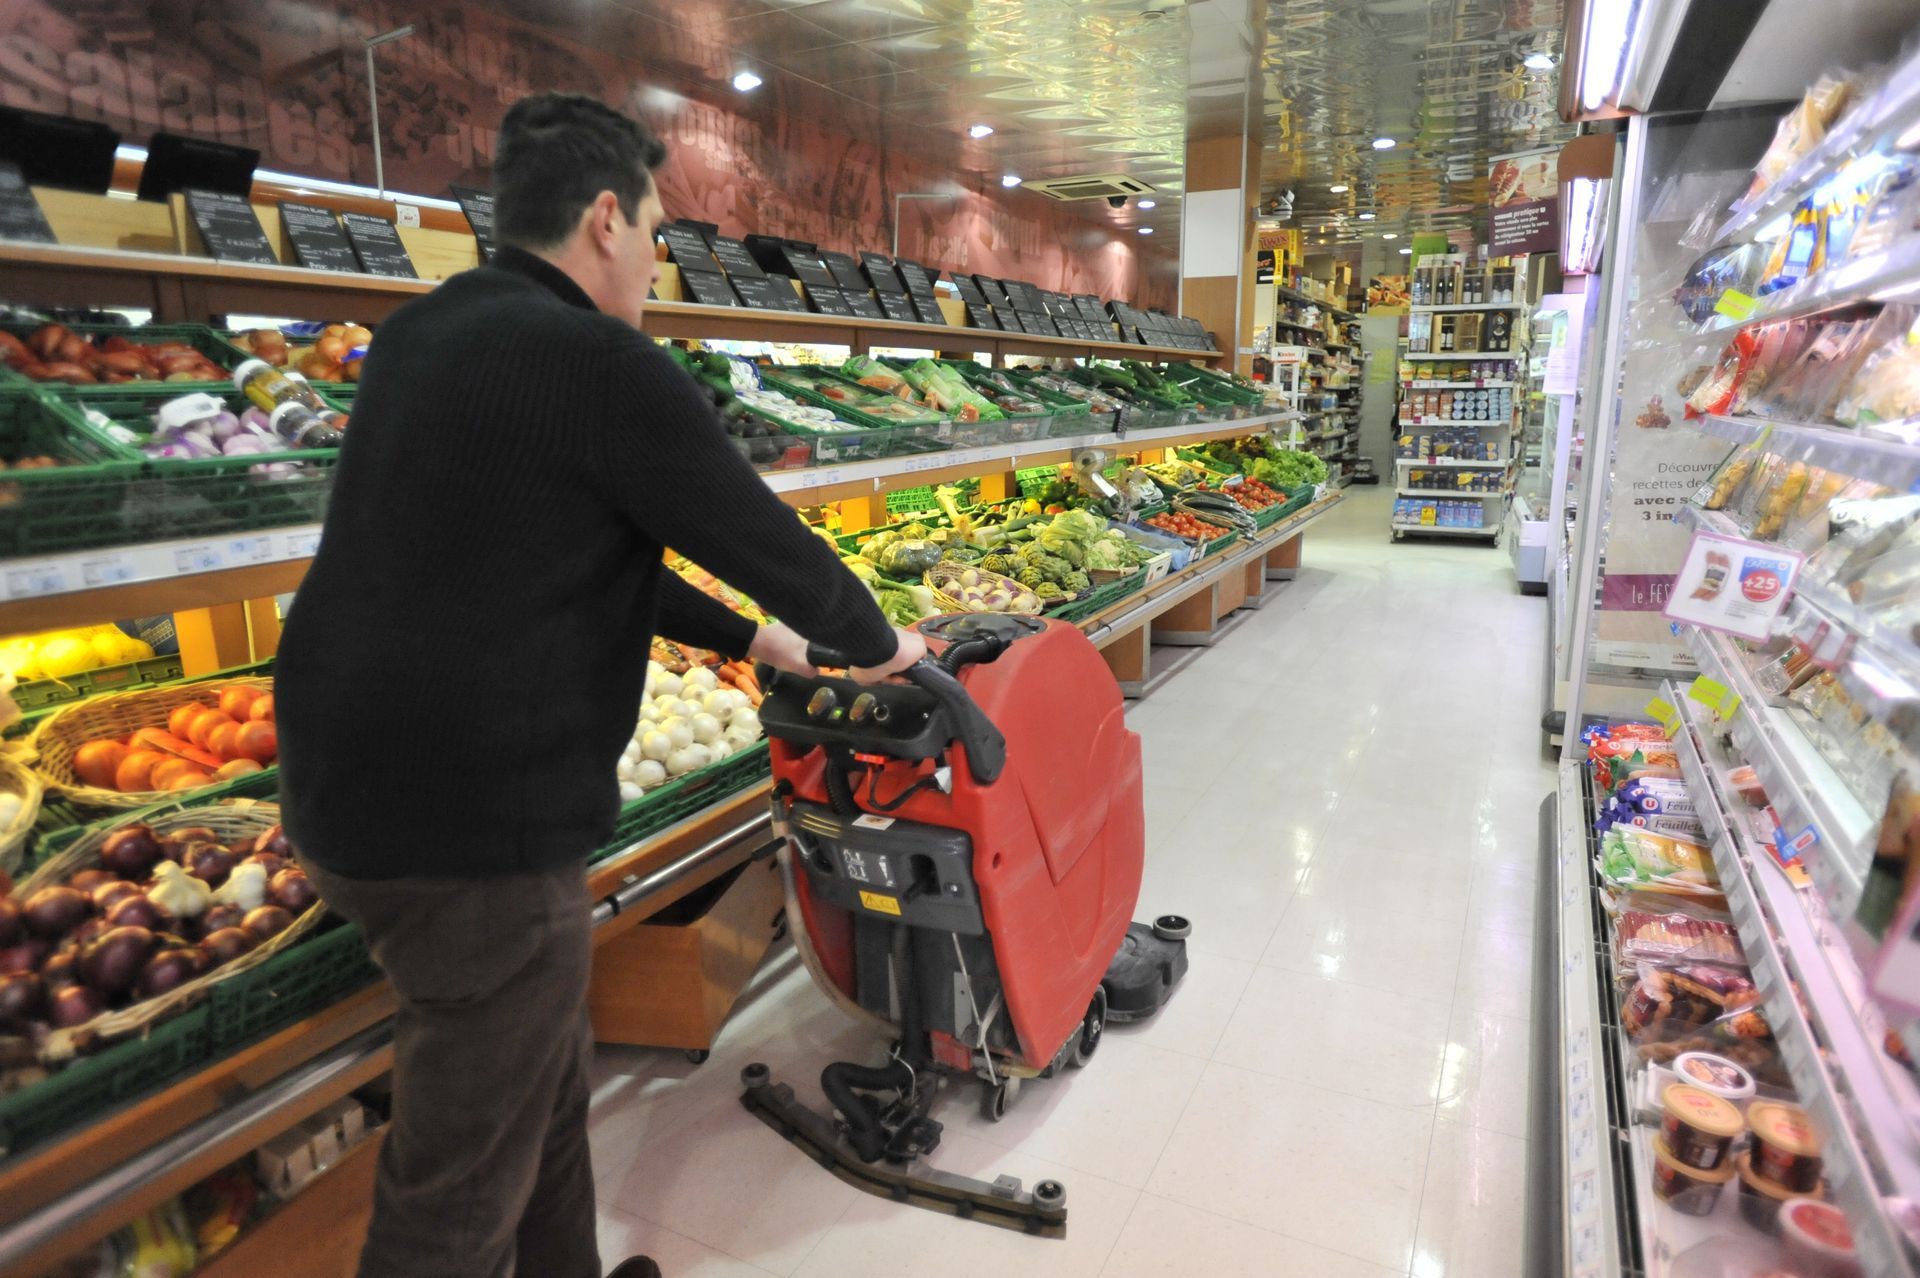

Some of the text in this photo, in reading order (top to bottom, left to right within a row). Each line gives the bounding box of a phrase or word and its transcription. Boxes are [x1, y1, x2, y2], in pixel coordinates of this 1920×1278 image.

[1633, 479, 1683, 490] recettes
[1634, 497, 1675, 505] avec
[1642, 511, 1651, 521] 3
[1744, 576, 1777, 590] +25
[1632, 583, 1674, 604] le FES
[1645, 799, 1655, 808] U
[1634, 817, 1644, 826] U
